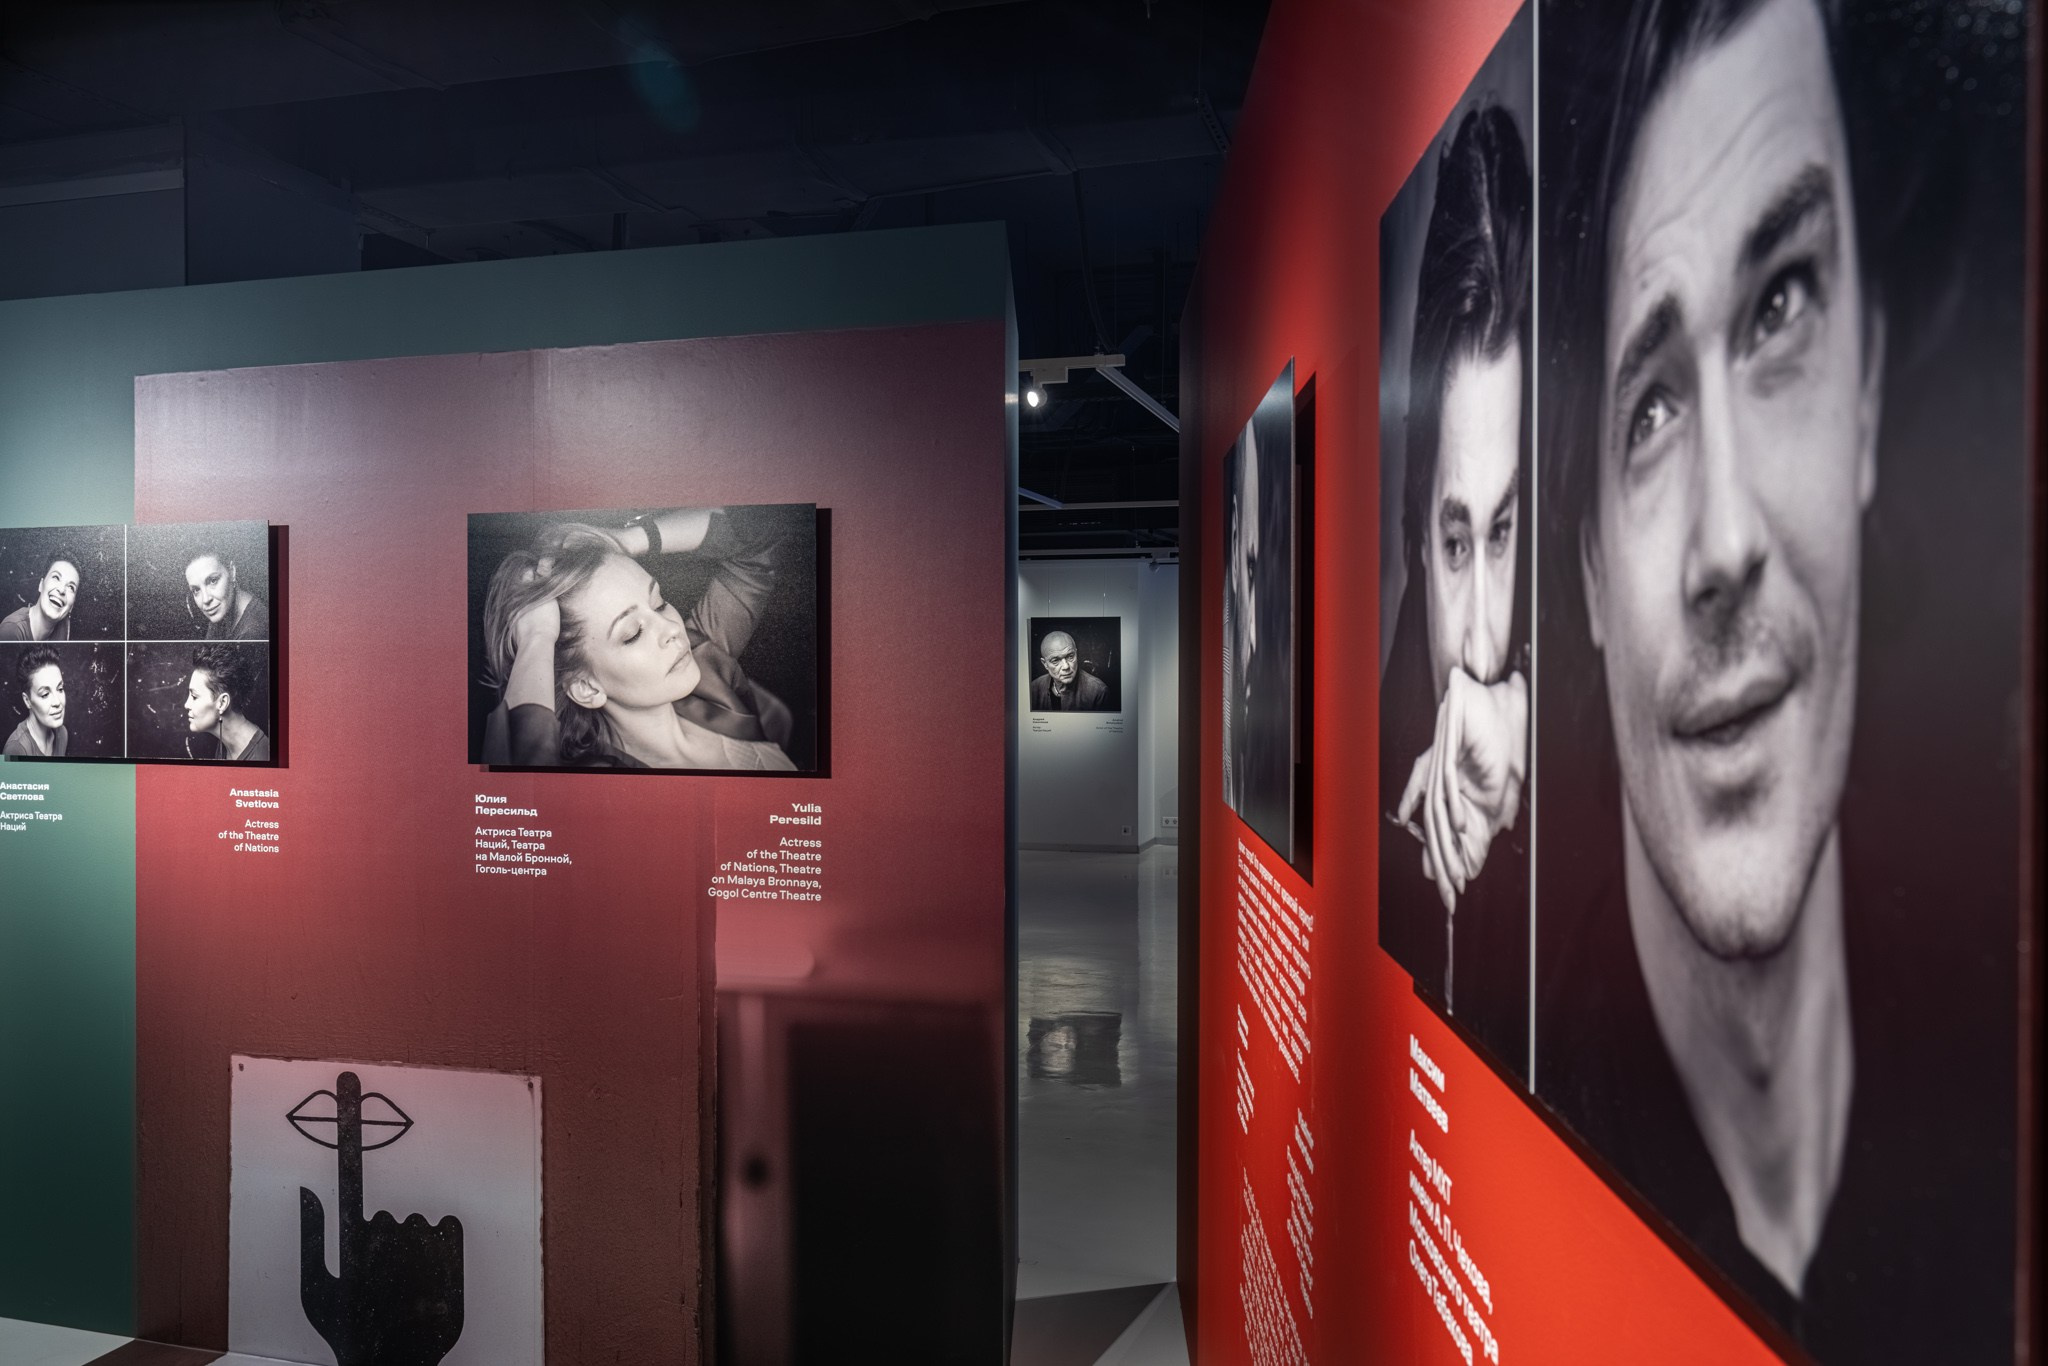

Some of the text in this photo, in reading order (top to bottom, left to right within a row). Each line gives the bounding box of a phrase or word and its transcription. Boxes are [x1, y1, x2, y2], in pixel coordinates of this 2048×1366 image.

[0, 782, 50, 791] Анастасия
[0, 792, 45, 801] Светлова
[229, 788, 280, 798] Anastasia
[475, 794, 507, 804] Юлия
[235, 799, 280, 809] Svetlova
[791, 803, 822, 813] Yulia
[0, 811, 63, 823] Актриса Театра
[475, 805, 538, 817] Пересильд
[244, 819, 280, 829] Actress
[769, 815, 822, 826] Peresild
[0, 822, 27, 832] Наций
[475, 826, 553, 840] Актриса Театра
[218, 830, 280, 841] of the Theatre
[233, 843, 280, 853] of Nations
[475, 839, 546, 852] Наций, Театра
[779, 837, 822, 848] Actress
[475, 852, 573, 865] на Малой Бронной,
[746, 849, 822, 862] of the Theatre
[475, 864, 548, 878] Гоголь-центра
[720, 862, 822, 875] of Nations, Theatre
[711, 875, 822, 890] on Malaya Bronnaya,
[707, 887, 822, 902] Gogol Centre Theatre
[1409, 1033, 1446, 1094] Максим
[1409, 1067, 1449, 1134] Матвеев
[1409, 1200, 1463, 1307] Московского
